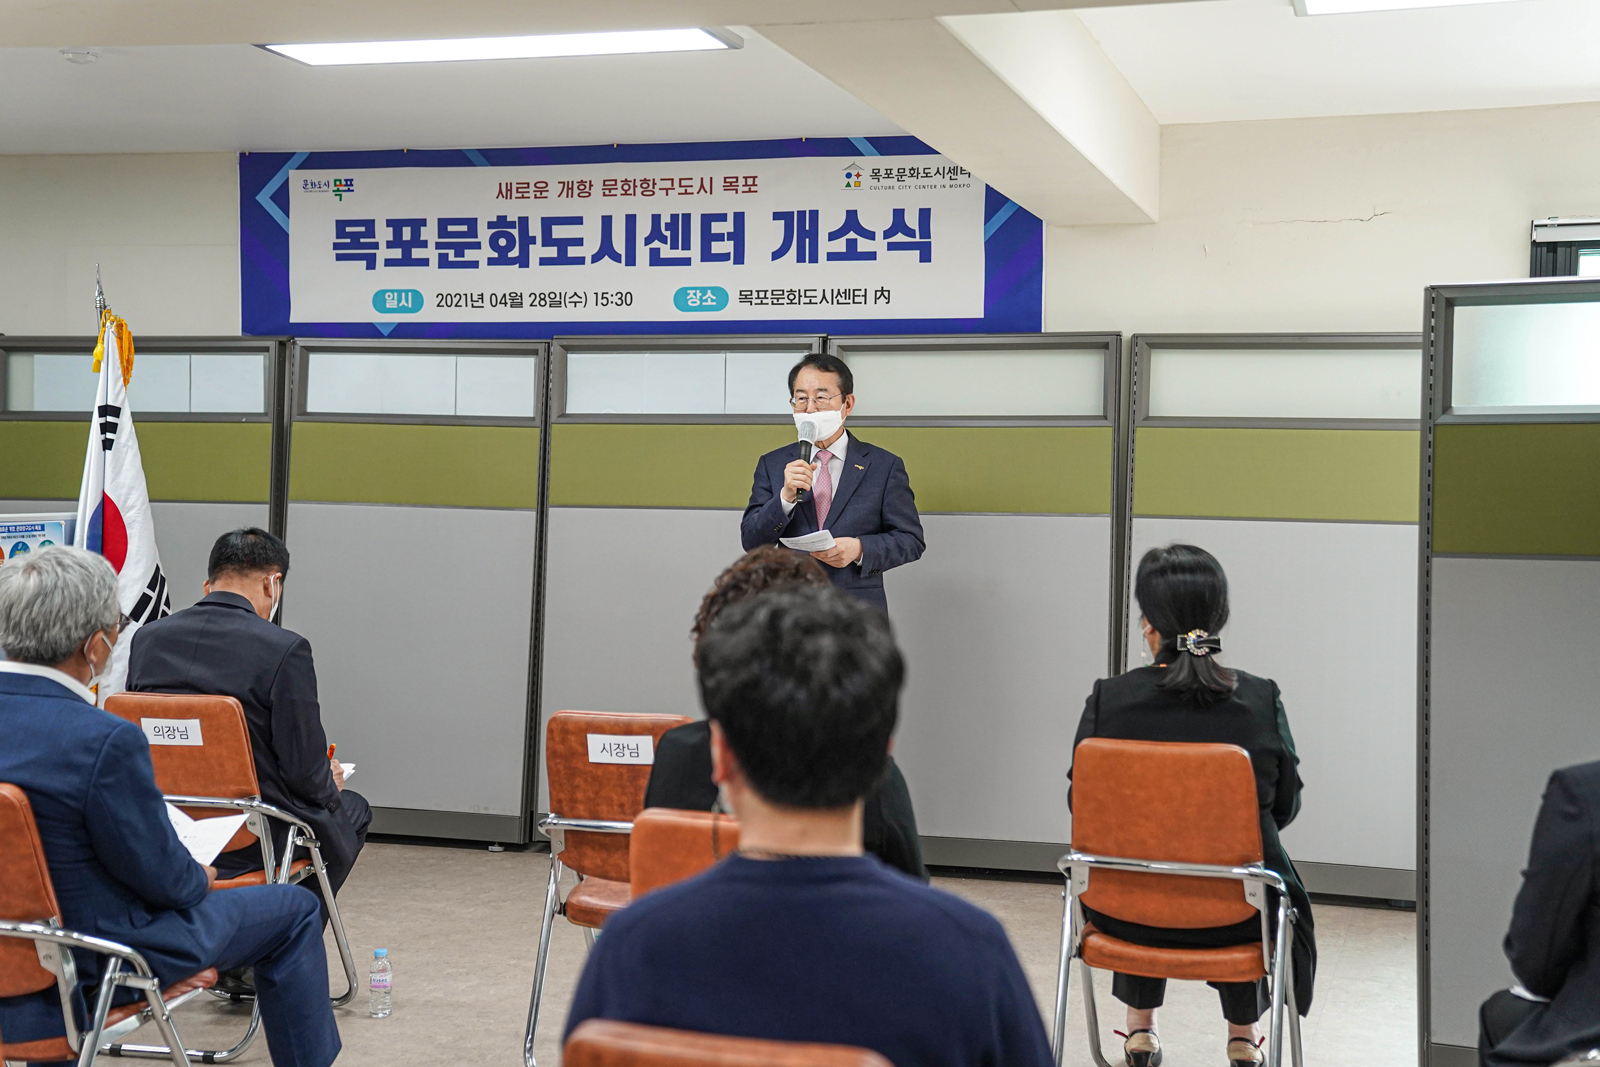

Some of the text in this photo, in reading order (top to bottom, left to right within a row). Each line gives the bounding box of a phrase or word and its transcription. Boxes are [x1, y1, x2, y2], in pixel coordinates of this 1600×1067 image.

[302, 178, 355, 202] 문화도시 목포
[496, 176, 759, 200] 새로운 개항 문화항구도시 목포
[332, 207, 932, 271] 목포문화도시센터 개소식
[384, 291, 413, 309] 일시
[435, 291, 633, 309] 2021년 04월 28일(수) 15:30
[686, 289, 717, 307] 장소
[738, 287, 868, 306] 목포문화도시센터
[153, 725, 189, 740] 의장님
[600, 742, 640, 758] 시장님
